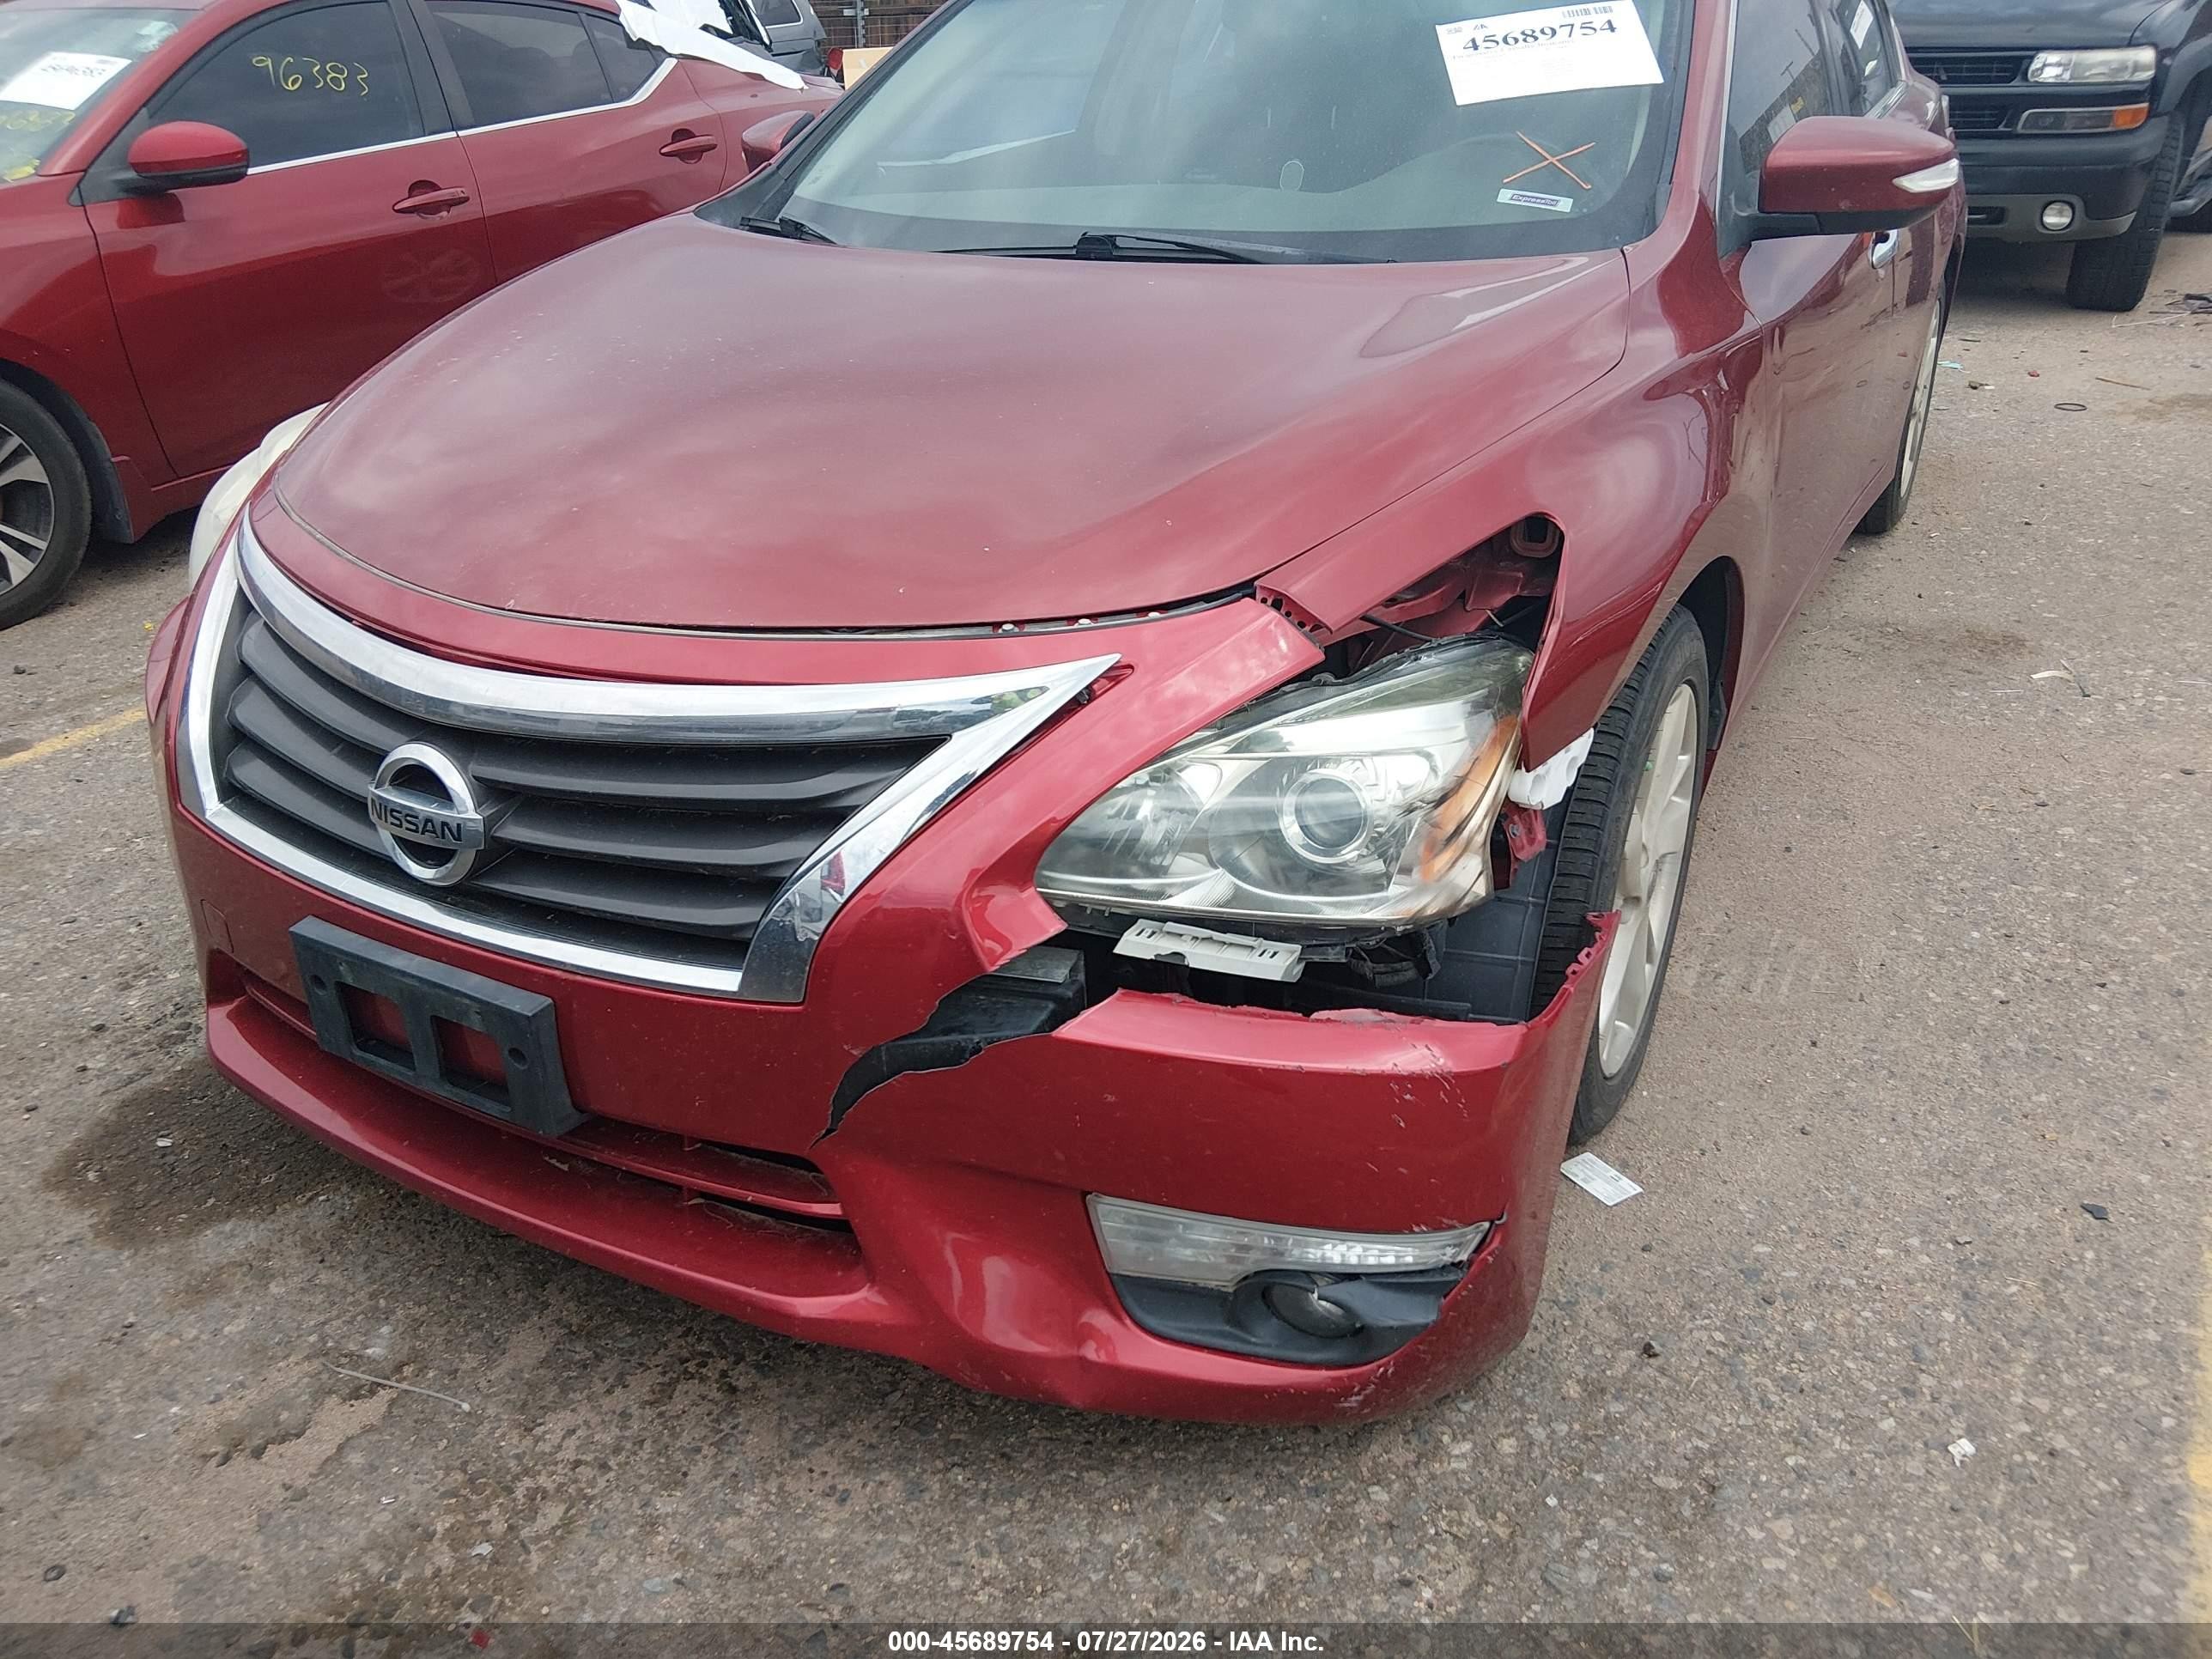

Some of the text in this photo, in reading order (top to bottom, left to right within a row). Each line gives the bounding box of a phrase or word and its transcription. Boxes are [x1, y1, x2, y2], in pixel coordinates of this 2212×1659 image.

[1462, 19, 1617, 51] 45689754
[252, 56, 369, 96] 96383
[370, 796, 463, 842] NISSAN
